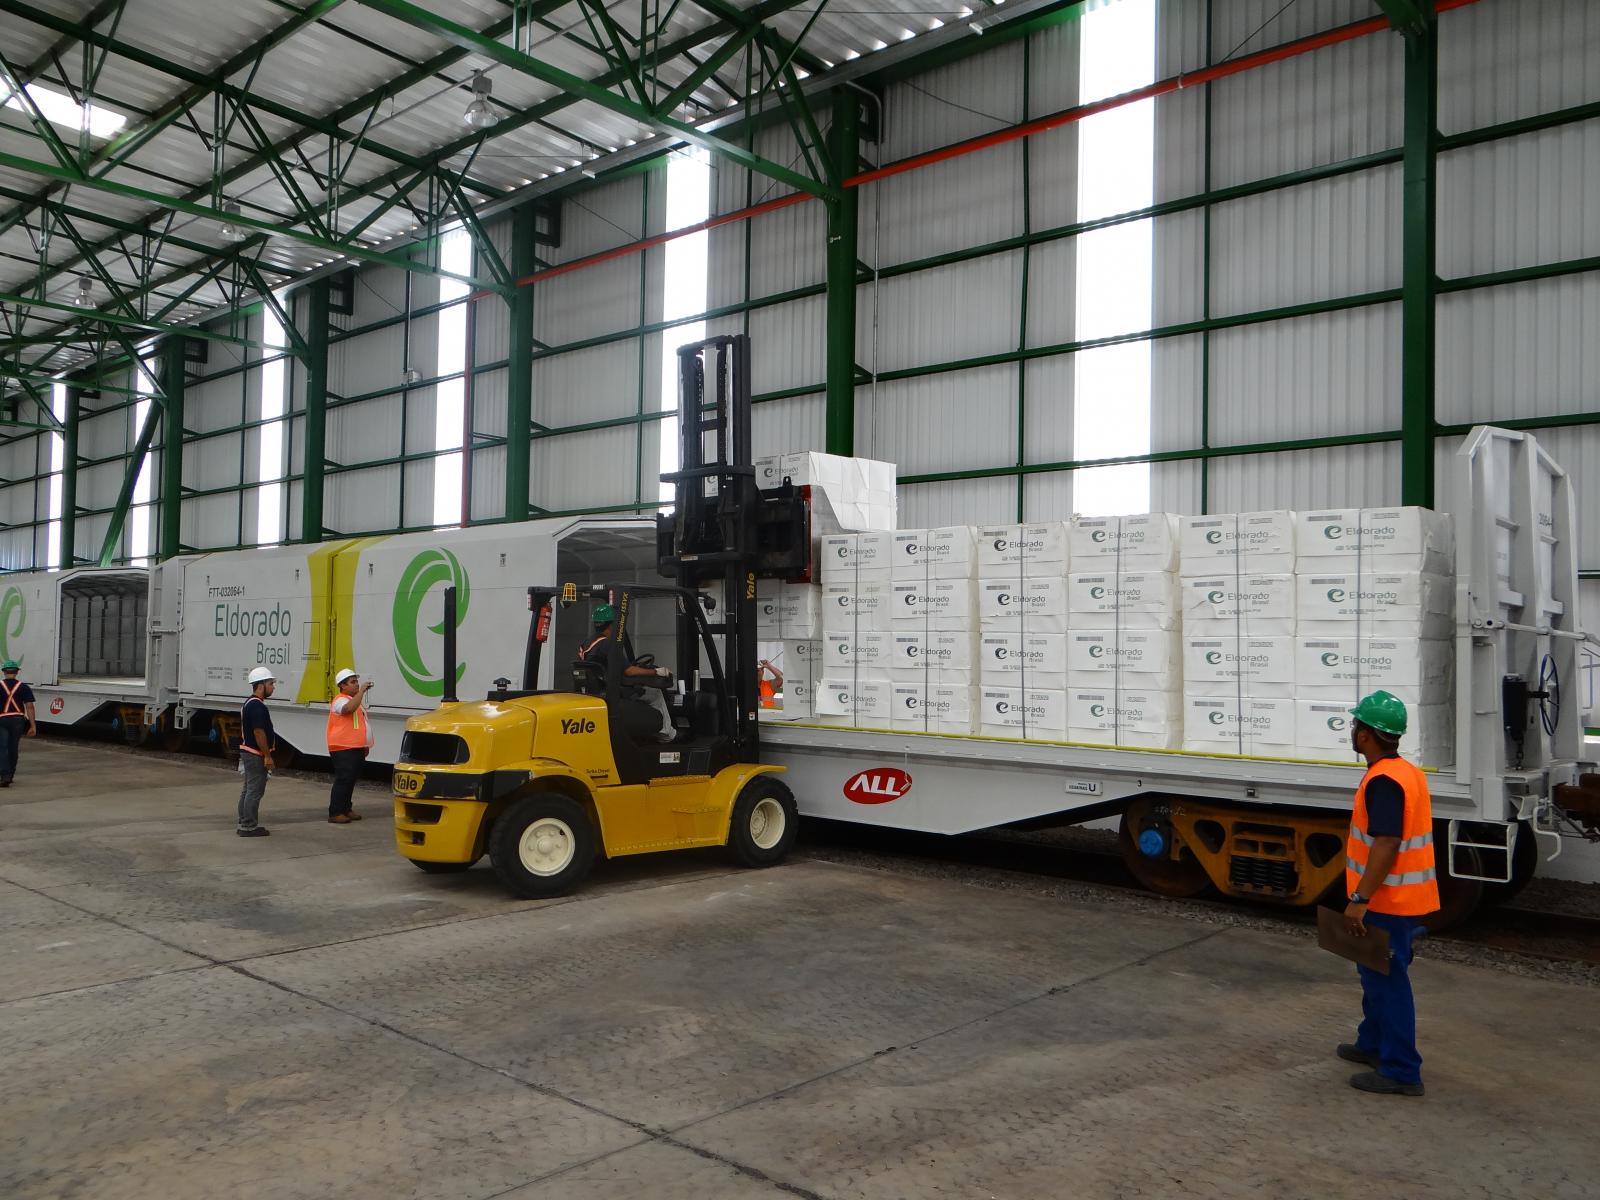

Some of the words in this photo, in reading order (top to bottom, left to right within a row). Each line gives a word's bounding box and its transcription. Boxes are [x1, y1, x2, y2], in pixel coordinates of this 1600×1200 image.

[747, 573, 755, 600] Yale
[1349, 590, 1397, 600] Edorado
[215, 602, 292, 638] Eldorado
[256, 642, 290, 665] Brasil
[921, 699, 949, 707] Edorado
[561, 718, 595, 735] Yale
[397, 774, 417, 790] Yale
[850, 774, 900, 796] ALL
